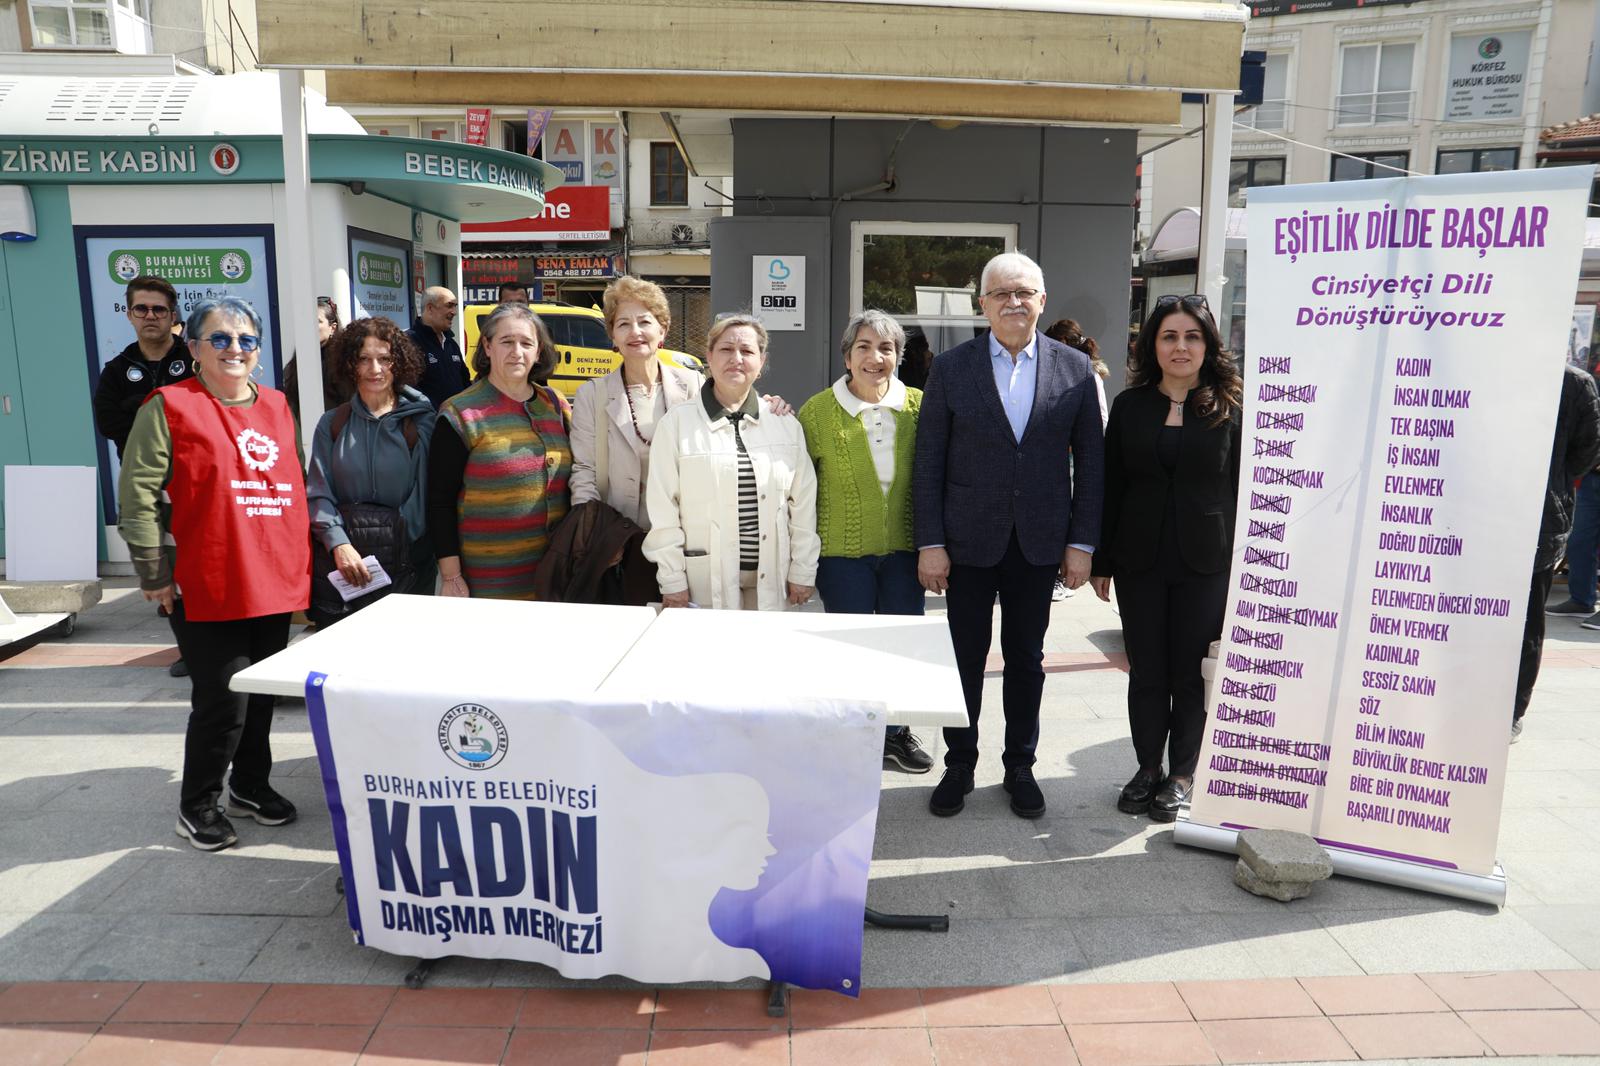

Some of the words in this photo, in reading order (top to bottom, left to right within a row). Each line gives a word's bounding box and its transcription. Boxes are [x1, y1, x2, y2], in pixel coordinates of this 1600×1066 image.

[1471, 60, 1506, 73] KÖRFEZ
[1452, 77, 1484, 88] HUKUK
[1485, 74, 1523, 86] BÜROSU
[100, 145, 197, 173] KABİNİ
[405, 152, 483, 181] BEBEK
[488, 163, 529, 191] BAKIM
[1274, 207, 1360, 263] EŞİTLİK
[1365, 203, 1436, 250] DİLDE
[1441, 206, 1549, 258] BAŞLAR
[146, 253, 211, 266] BURHANİYE
[537, 258, 567, 269] SENA
[570, 258, 609, 269] EMLAK
[146, 266, 212, 279] BELEDİYESİ
[184, 288, 203, 300] İçin
[1311, 273, 1434, 299] Cinsiyetçi
[1442, 272, 1494, 294] Dili
[762, 296, 796, 307] BTT
[1296, 305, 1506, 331] Dönüştürüyoruz
[1396, 358, 1431, 377] KADIN
[1394, 385, 1429, 407] İNSAN
[1432, 389, 1471, 408] OLMAK
[1391, 417, 1412, 436] TEK
[1414, 418, 1454, 441] BAŞINA
[1387, 444, 1399, 468] İŞ
[1402, 444, 1440, 467] İNSANI
[1385, 476, 1444, 497] EVLENMEK
[235, 496, 292, 507] BURHANİYE
[246, 507, 282, 518] ŞUBESİ
[1381, 501, 1433, 525] İNSANLIK
[1379, 531, 1415, 552] DOĞRU
[1419, 534, 1462, 556] DÜZGÜN
[1375, 561, 1431, 583] LAYIKIYLA
[1262, 578, 1297, 598] SOYADI
[1236, 600, 1256, 619] ADAM
[1294, 608, 1338, 628] KOYMAK
[1372, 589, 1435, 612] EVLENMEDEN
[1437, 593, 1472, 614] ÖNCEKİ
[1474, 598, 1510, 616] SOYADI
[1370, 614, 1401, 636] ÖNEM
[1404, 620, 1449, 642] VERMEK
[1366, 644, 1420, 666] KADINLAR
[1362, 671, 1400, 691] SESSİZ
[1402, 675, 1436, 696] SAKİN
[1360, 696, 1380, 716] SÖZ
[1356, 722, 1386, 743] BİLİM
[1388, 726, 1425, 749] İNSANI
[1260, 736, 1292, 756] BENDE
[1294, 742, 1331, 761] KALSIN
[1210, 755, 1238, 772] ADAM
[1240, 759, 1274, 779] ADAMA
[1278, 765, 1328, 786] OYNAMAK
[1353, 748, 1408, 773] BÜYÜKLÜK
[1410, 758, 1446, 780] BENDE
[1448, 764, 1487, 784] KALSIN
[364, 774, 477, 800] BURHANİYE
[484, 779, 597, 810] BELEDİYESİ
[1207, 779, 1235, 797] ADAM
[1260, 787, 1308, 809] OYNAMAK
[1350, 774, 1374, 794] BİRE
[1376, 779, 1394, 798] BİR
[1397, 783, 1450, 807] OYNAMAK
[1347, 801, 1394, 824] BAŞARILI
[1397, 810, 1451, 834] OYNAMAK
[367, 798, 598, 914] KADIN
[380, 900, 496, 943] DANIŞMA
[503, 907, 603, 954] MERKEZİ
